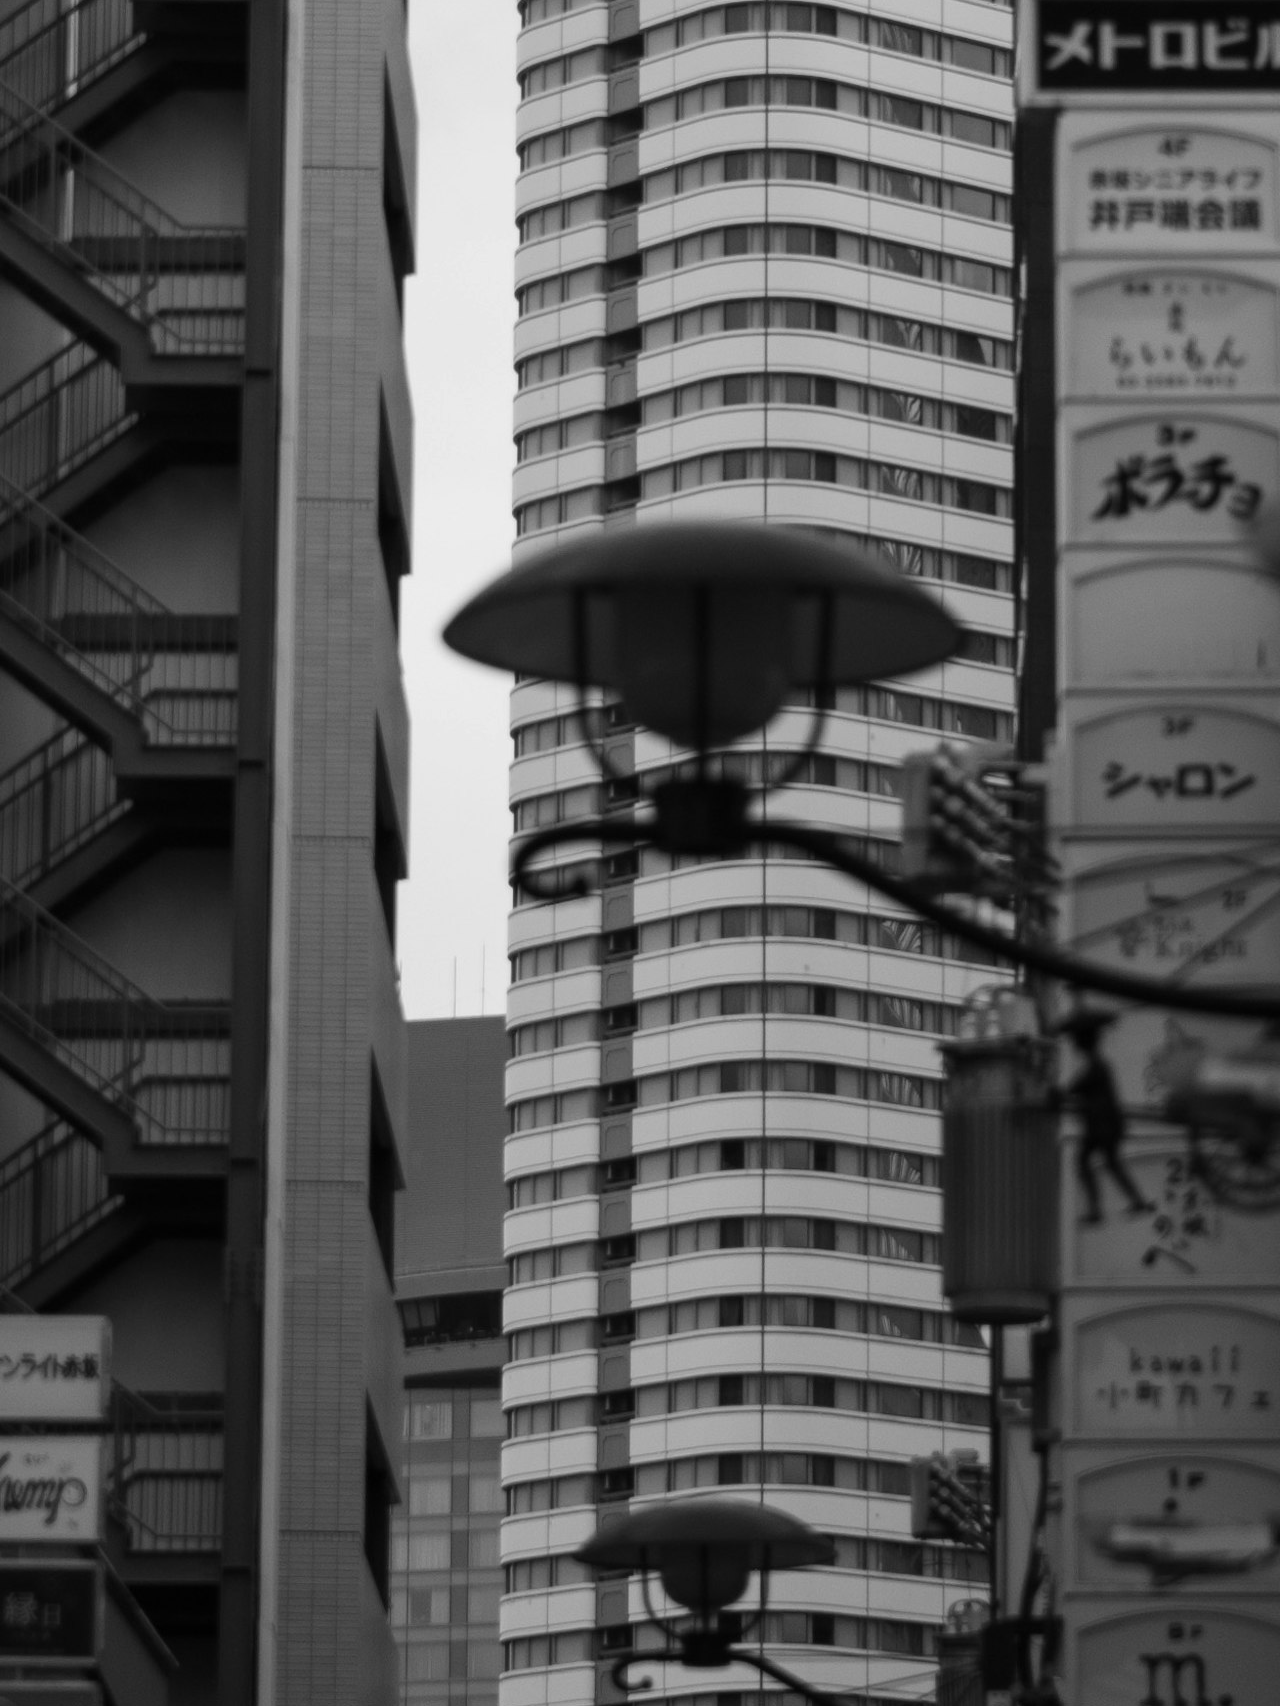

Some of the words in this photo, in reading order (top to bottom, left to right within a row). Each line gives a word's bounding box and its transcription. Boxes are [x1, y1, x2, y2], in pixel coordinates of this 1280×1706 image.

[1158, 137, 1191, 156] 4F
[1089, 199, 1262, 233] 井戸端会議
[1103, 761, 1256, 799] シャロン
[1097, 1381, 1272, 1410] 小町カフェ
[1167, 1466, 1205, 1491] 1F
